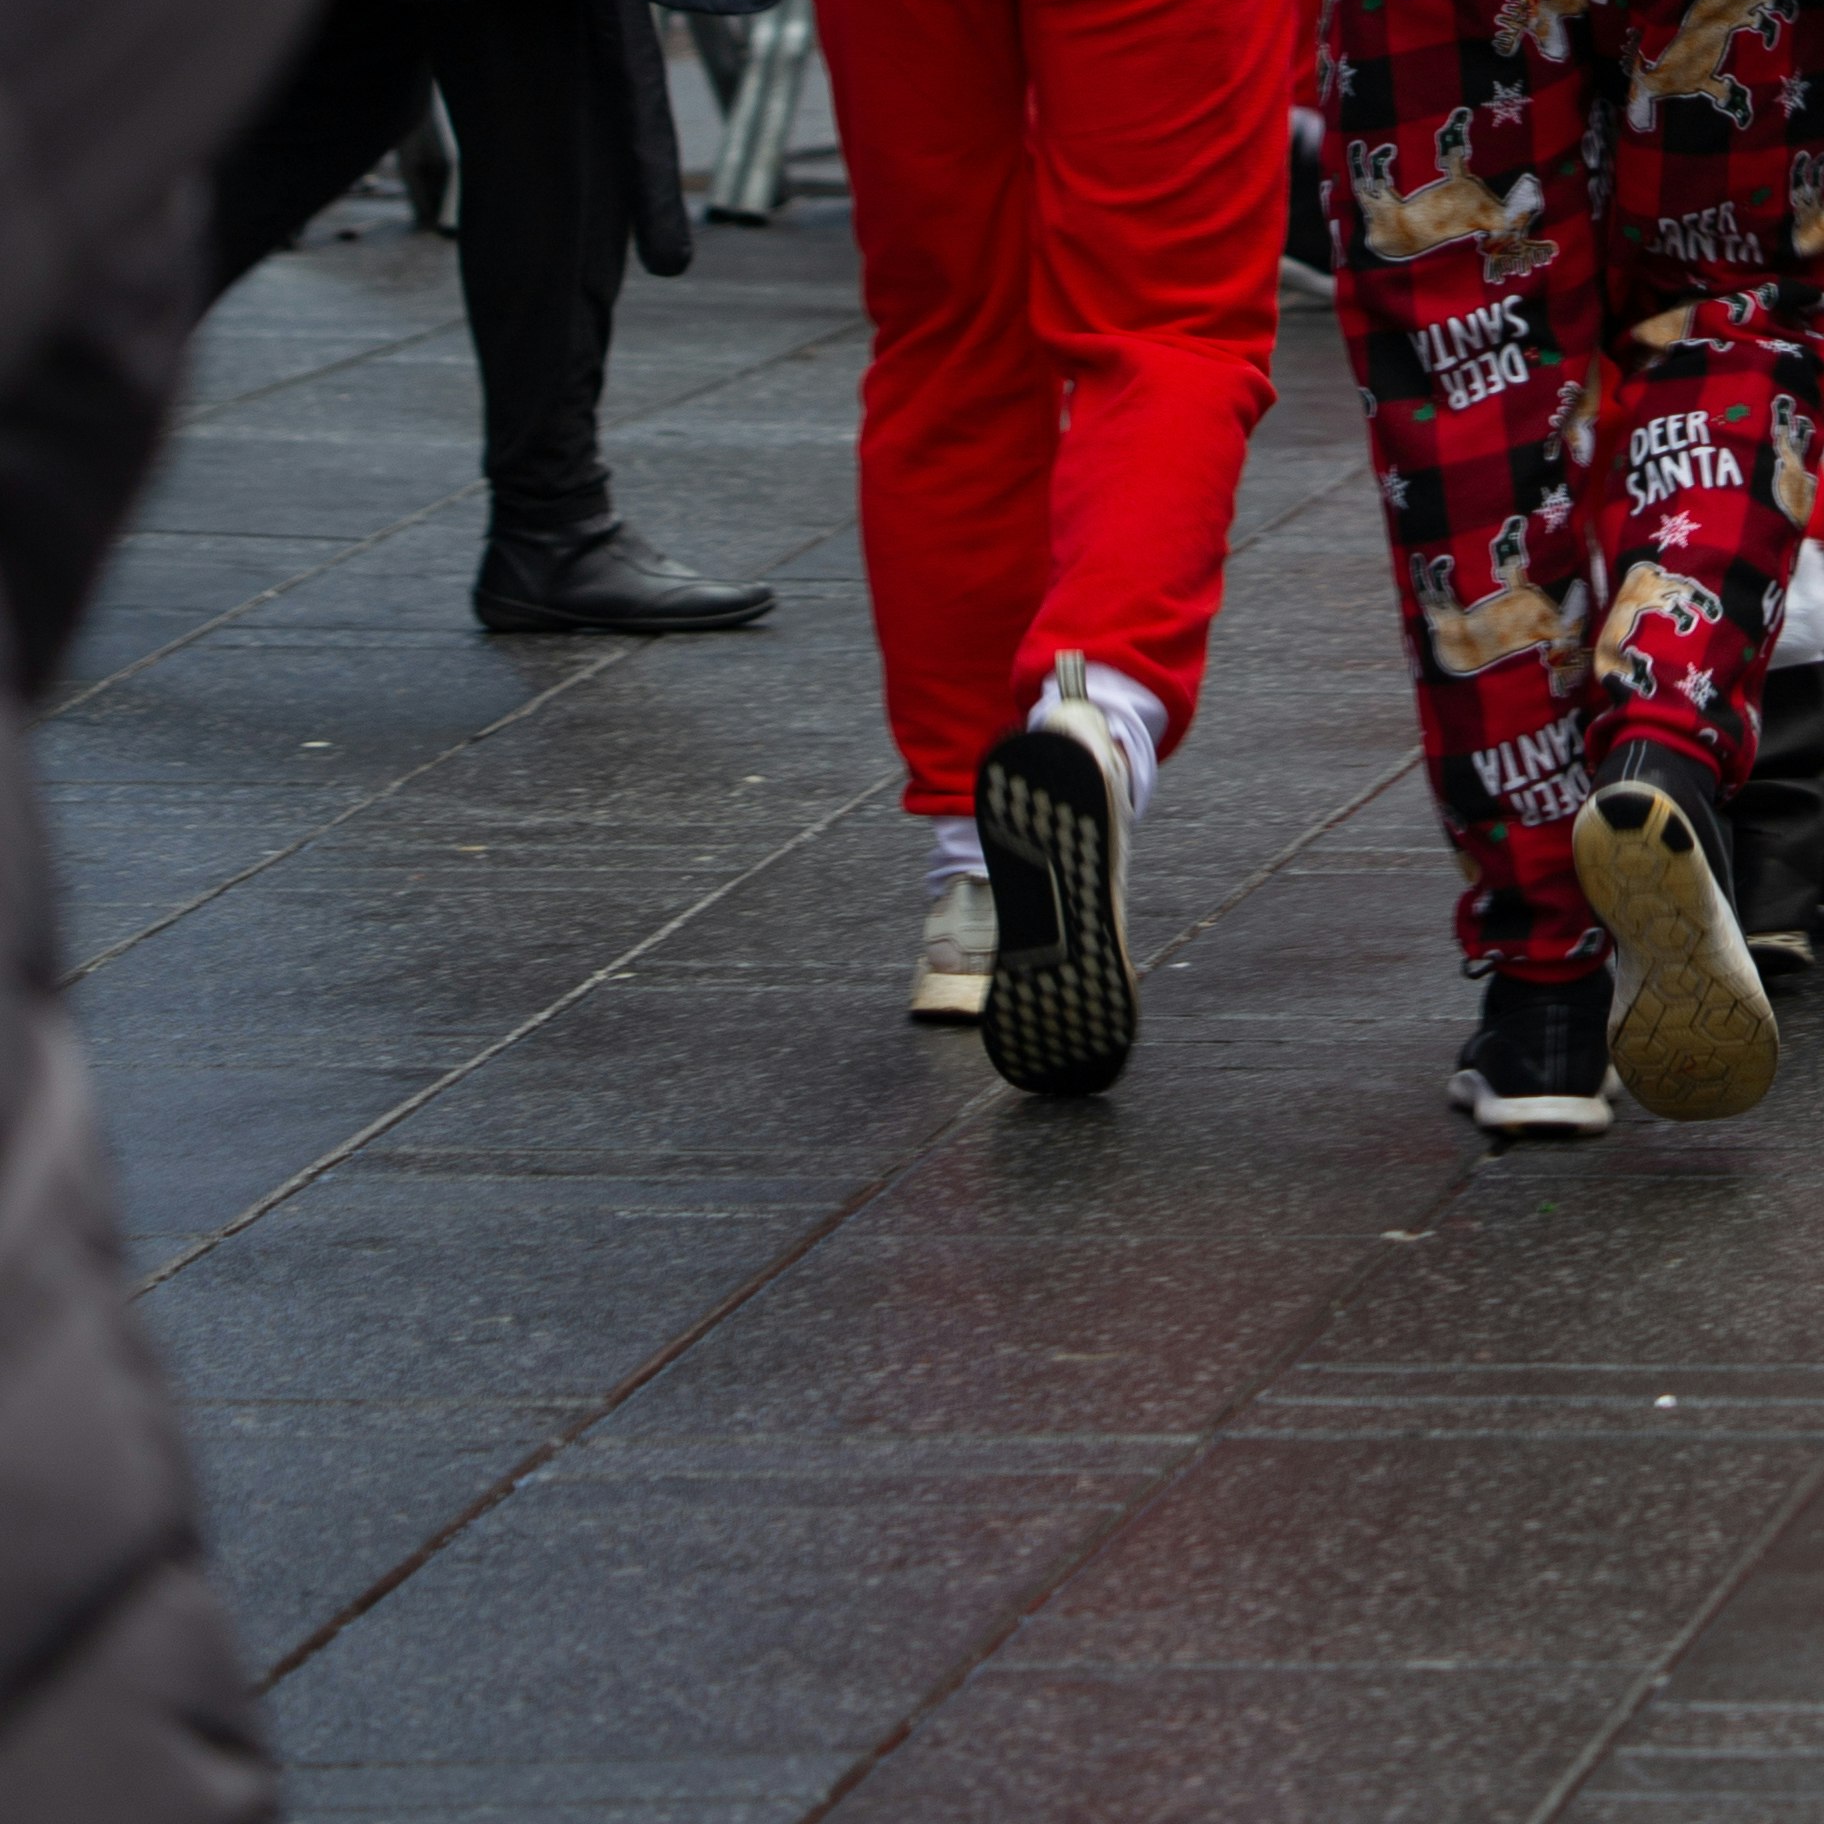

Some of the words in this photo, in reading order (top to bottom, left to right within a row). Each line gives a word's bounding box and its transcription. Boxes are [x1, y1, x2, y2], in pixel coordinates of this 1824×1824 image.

[1408, 294, 1529, 373] SANTA
[1441, 343, 1530, 410] DEER
[1629, 410, 1710, 467] DEER
[1625, 446, 1744, 516] SANTA
[1511, 764, 1591, 827] DEER
